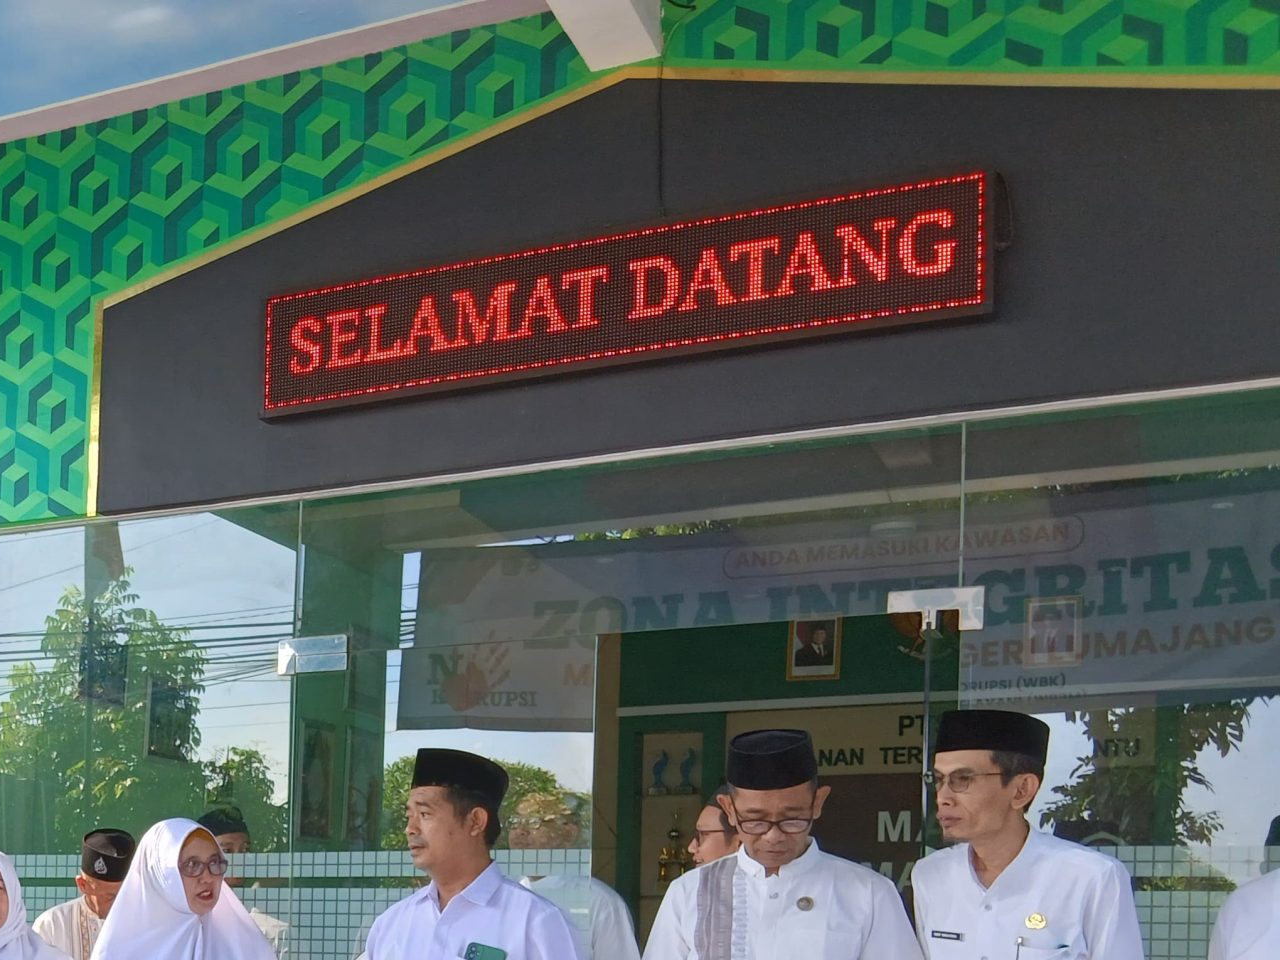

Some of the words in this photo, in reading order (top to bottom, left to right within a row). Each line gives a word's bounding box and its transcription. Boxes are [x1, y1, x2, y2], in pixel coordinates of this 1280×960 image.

[289, 267, 607, 376] SELAMAT
[626, 210, 956, 321] DATANG
[735, 550, 800, 569] ANDA
[807, 539, 931, 563] MEMASUKI
[935, 521, 1070, 556] KAWASAN
[523, 588, 735, 650] ZONA
[1016, 672, 1067, 692] (WBK)
[818, 748, 864, 767] NAN
